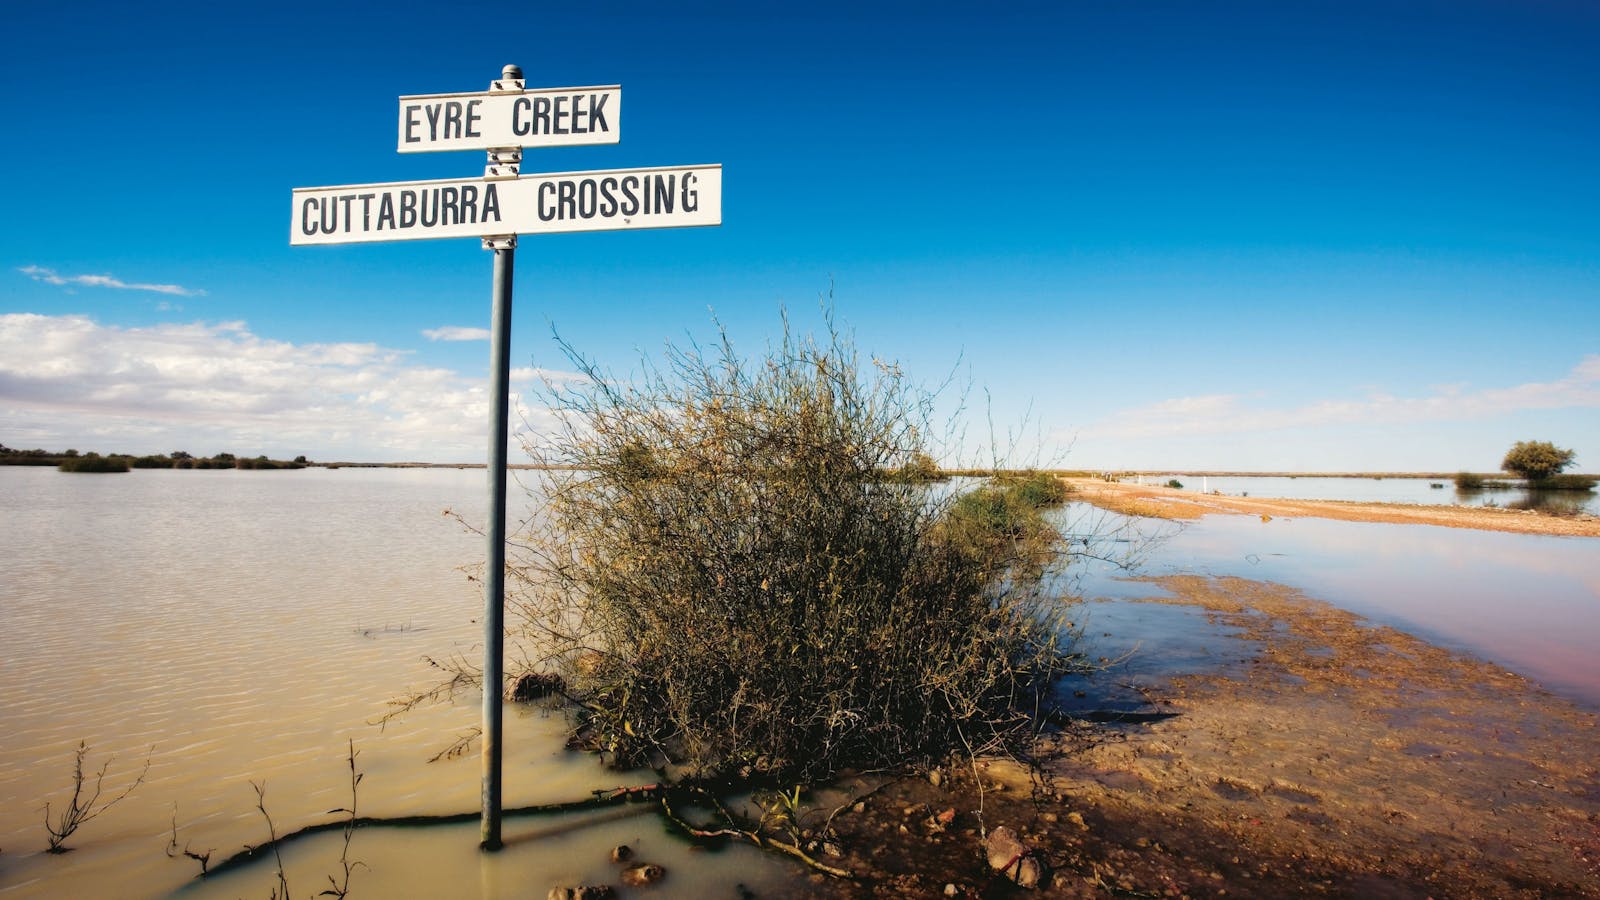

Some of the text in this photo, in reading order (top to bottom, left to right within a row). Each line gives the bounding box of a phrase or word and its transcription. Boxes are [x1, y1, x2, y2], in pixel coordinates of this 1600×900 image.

[405, 93, 609, 143] EYRE CREEK
[302, 172, 698, 236] CUTTABURRA CROSSING
